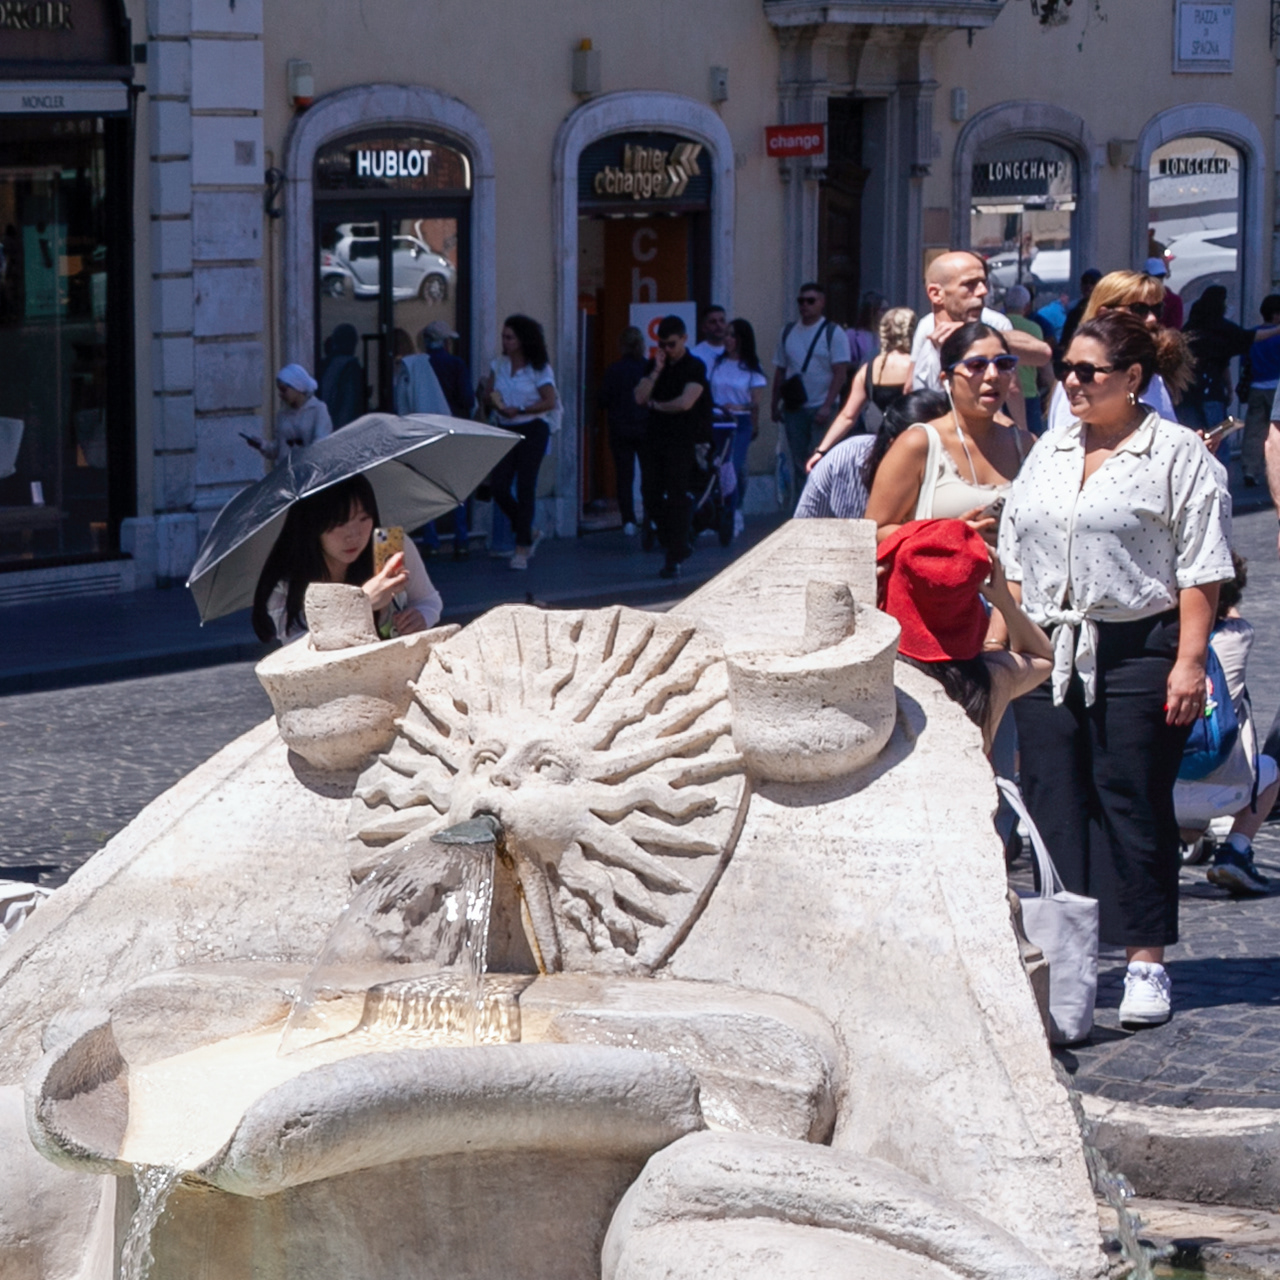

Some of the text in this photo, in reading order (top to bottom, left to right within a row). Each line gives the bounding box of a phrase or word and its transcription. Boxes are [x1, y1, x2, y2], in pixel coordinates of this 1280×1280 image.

[1194, 9, 1219, 24] PIAZZA
[21, 95, 66, 109] MONCLER
[769, 135, 820, 150] change
[357, 149, 432, 177] HUBLOT
[988, 161, 1065, 181] LONGCHAMP
[1165, 157, 1231, 176] LONGCHAMP
